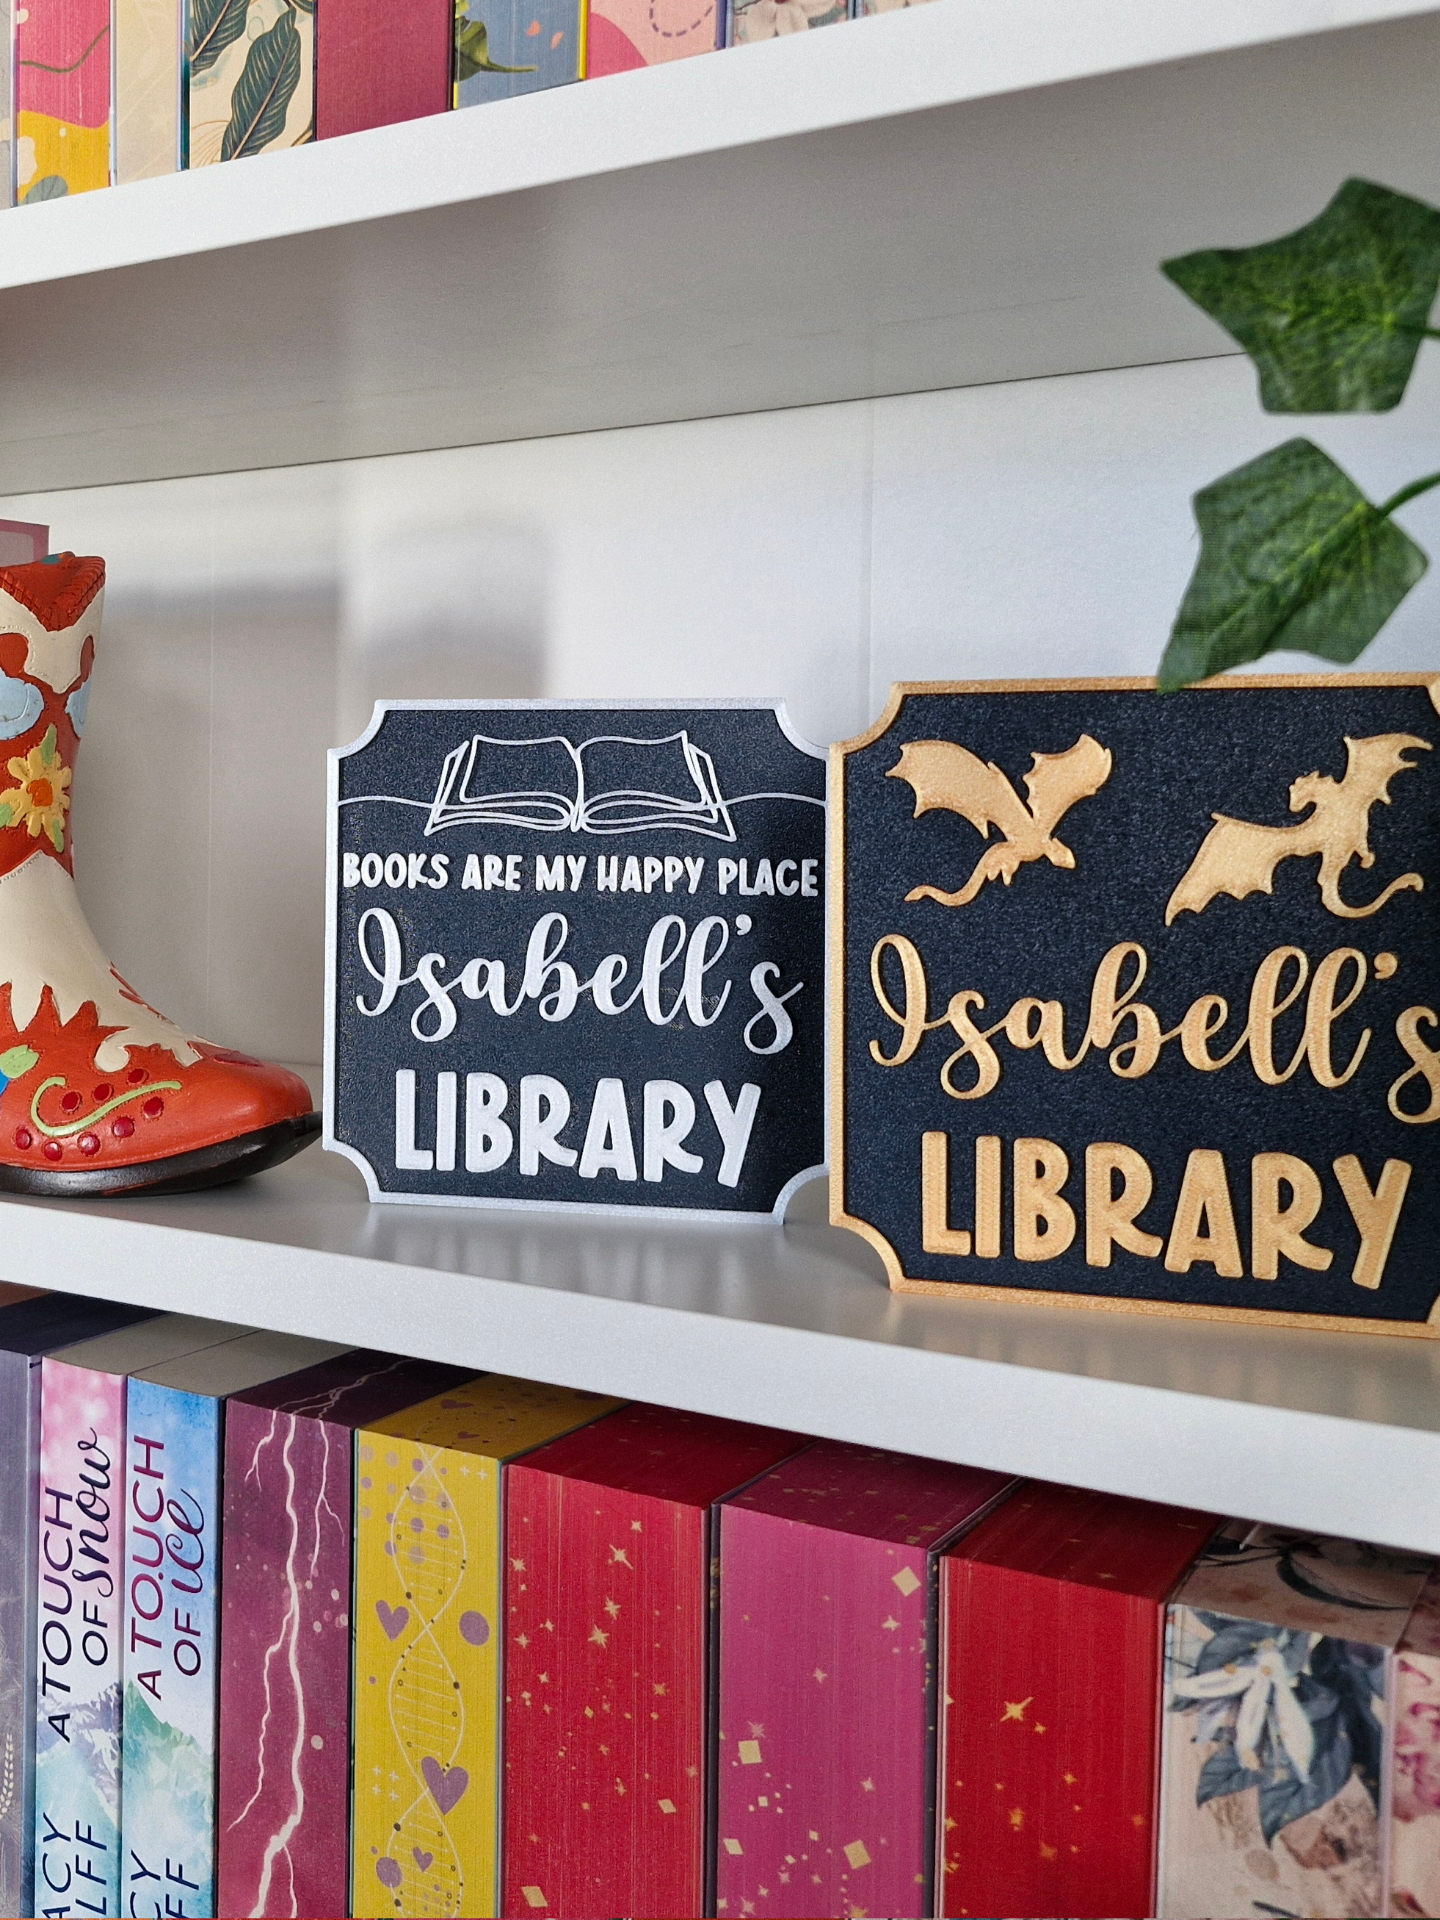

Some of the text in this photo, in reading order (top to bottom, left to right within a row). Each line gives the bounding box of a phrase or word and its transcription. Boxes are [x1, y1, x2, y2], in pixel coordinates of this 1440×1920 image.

[342, 852, 820, 897] BOOKS ARE MY HAPPY PLACE
[355, 907, 805, 1055] Isabell's
[395, 1068, 762, 1188] LIBRARY
[921, 1130, 1413, 1290] LIBRARY
[42, 1486, 73, 1744] A TOUCH
[82, 1599, 108, 1666] OF
[131, 1434, 164, 1701] A TOUCH
[173, 1607, 202, 1677] OF
